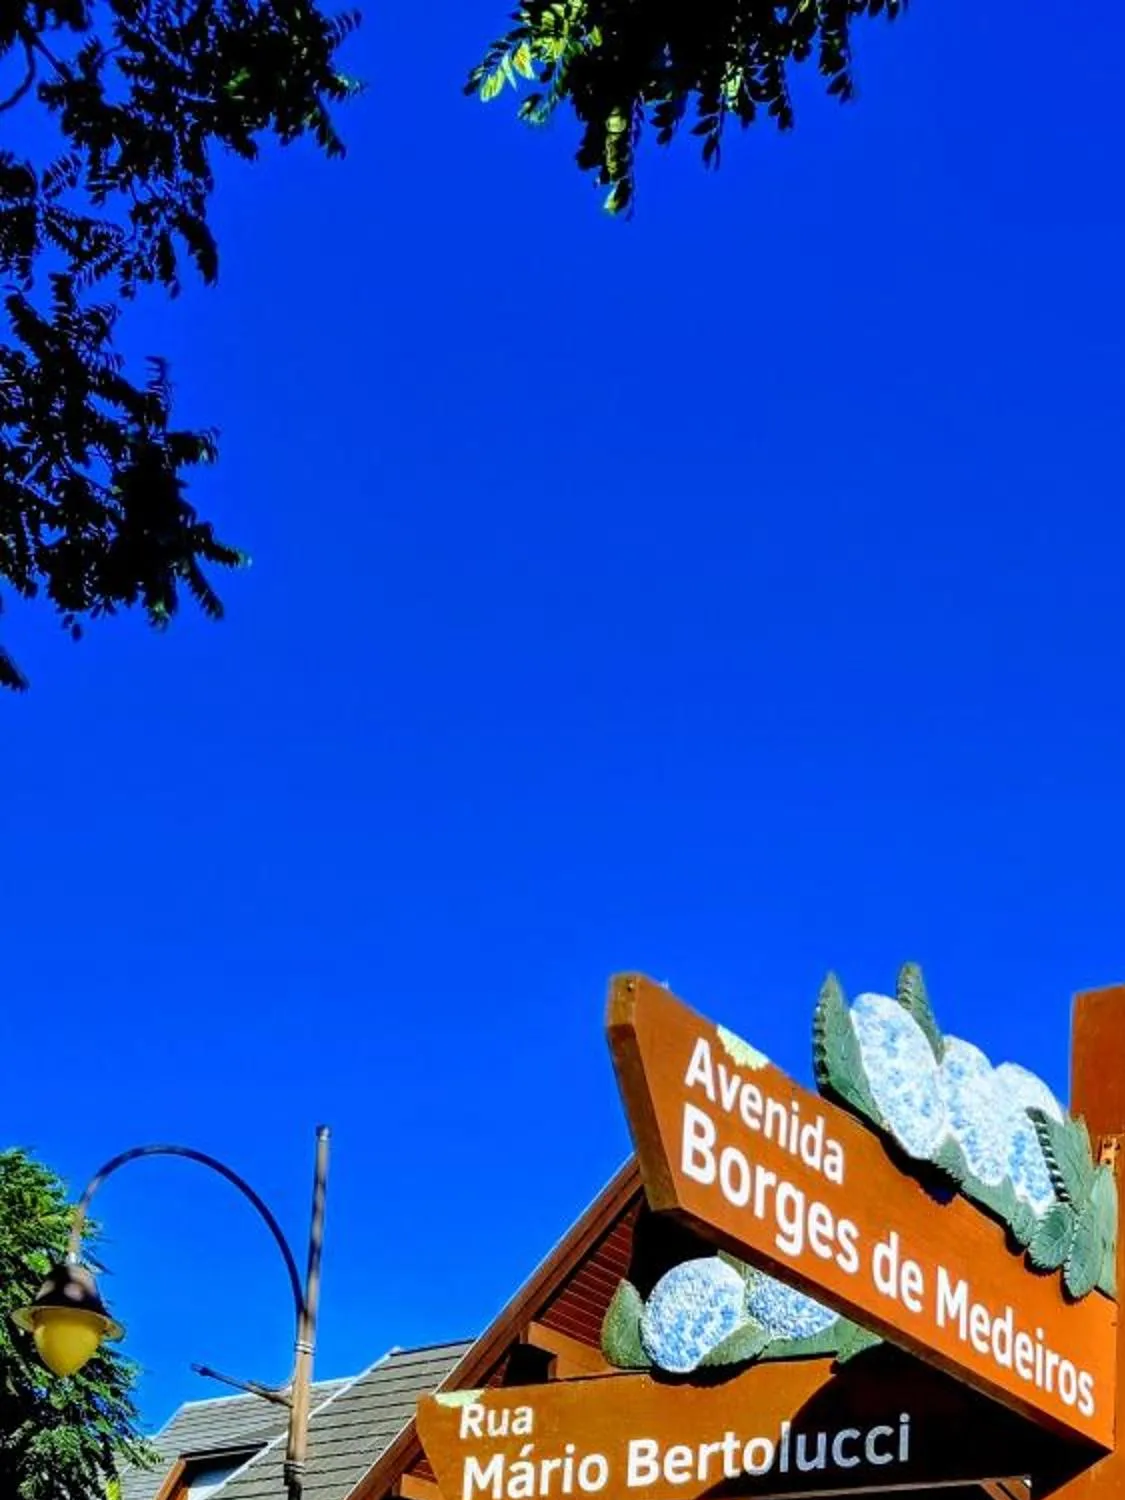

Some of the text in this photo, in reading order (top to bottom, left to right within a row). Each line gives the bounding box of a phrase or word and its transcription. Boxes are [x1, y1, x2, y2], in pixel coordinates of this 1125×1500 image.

[684, 1037, 845, 1185] Avenida
[681, 1103, 1095, 1418] Borges de Medeiros
[459, 1403, 535, 1439] Rua
[626, 1413, 911, 1488] Bertolucci
